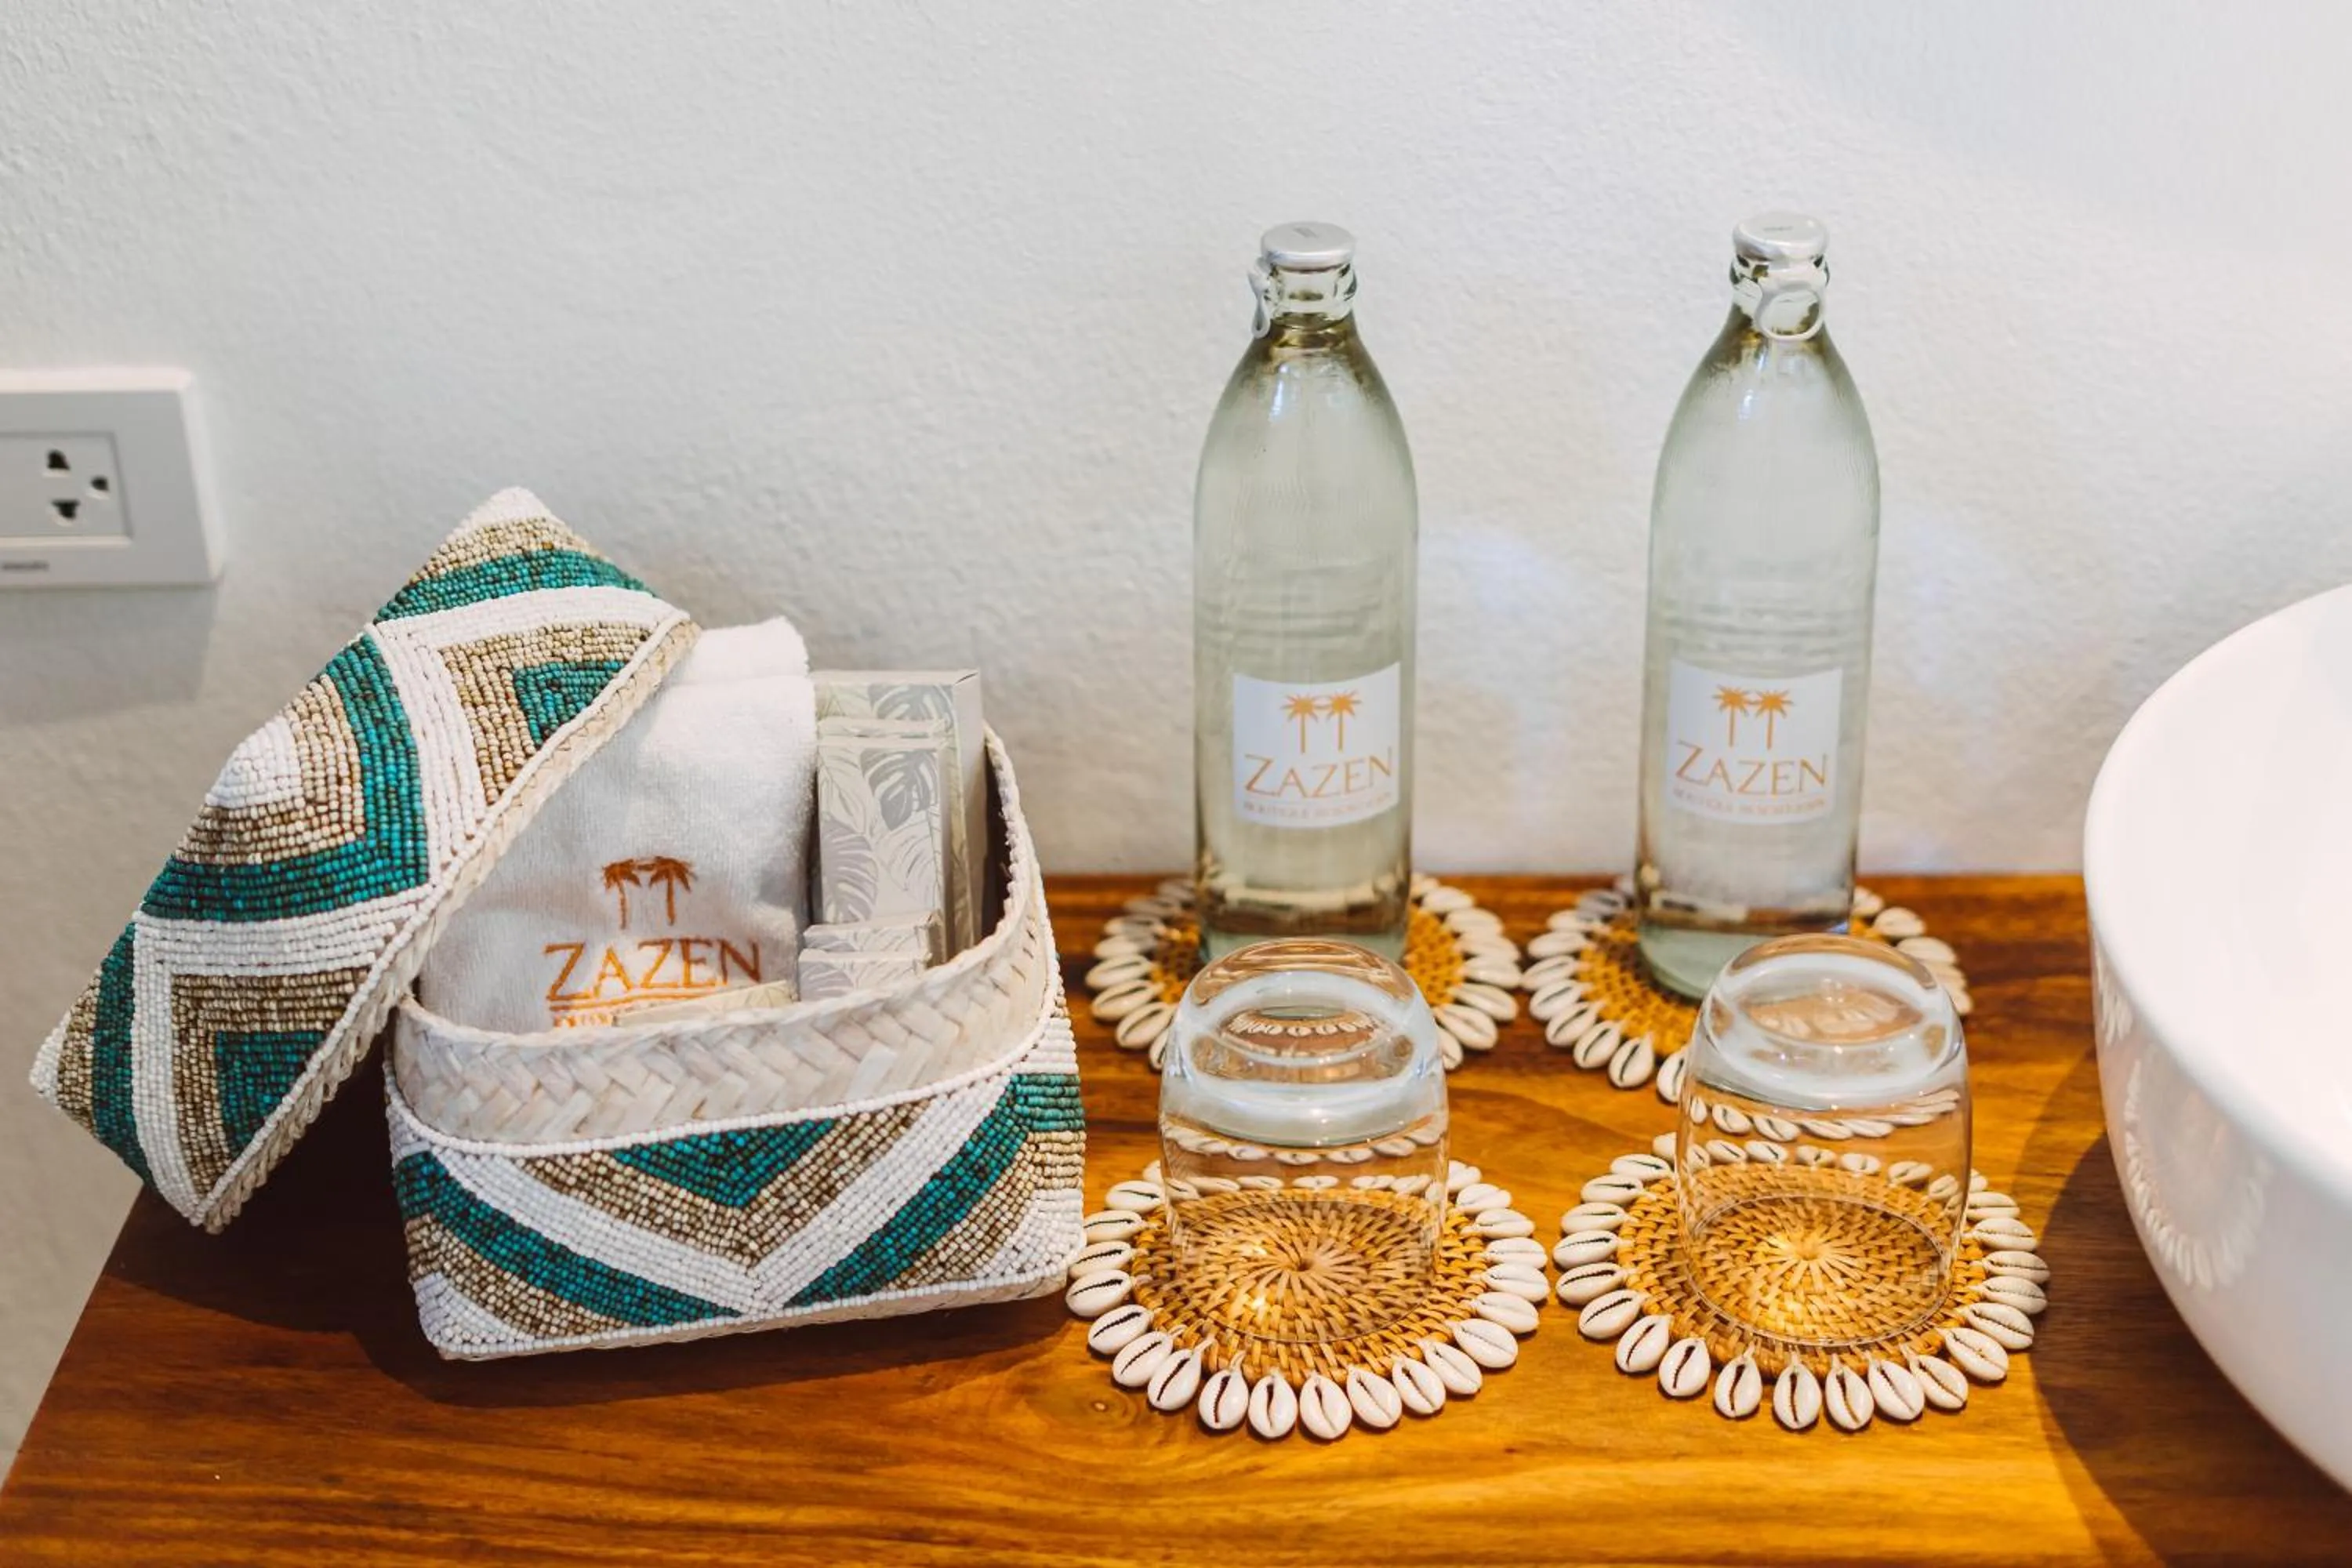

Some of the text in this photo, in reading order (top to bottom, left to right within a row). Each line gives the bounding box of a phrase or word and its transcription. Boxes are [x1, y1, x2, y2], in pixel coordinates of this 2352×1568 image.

[1244, 746, 1392, 798] ZAZEN
[1675, 739, 1828, 796] ZAZEN
[543, 938, 762, 1002] ZAZEN
